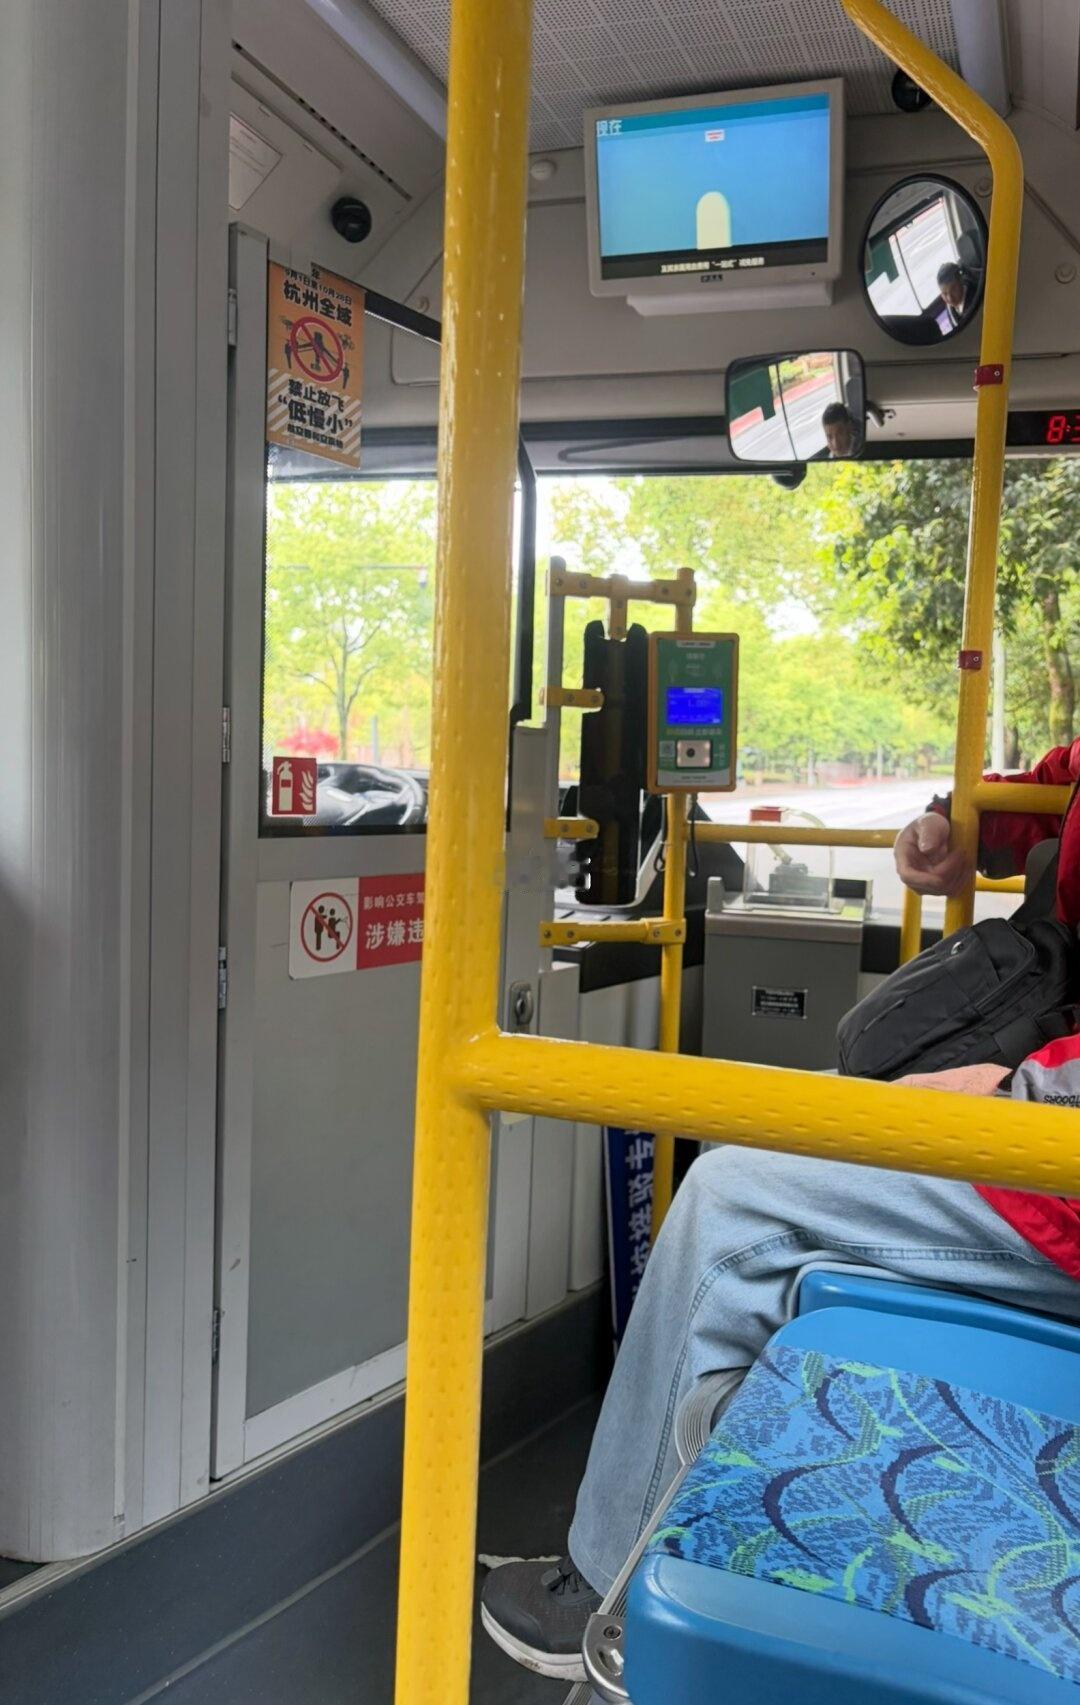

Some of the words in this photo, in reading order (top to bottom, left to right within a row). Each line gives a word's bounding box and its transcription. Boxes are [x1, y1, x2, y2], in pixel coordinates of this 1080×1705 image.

[284, 280, 352, 327] 杭州全域
[288, 379, 344, 412] 禁止放飞
[366, 918, 425, 950] 涉嫌违
